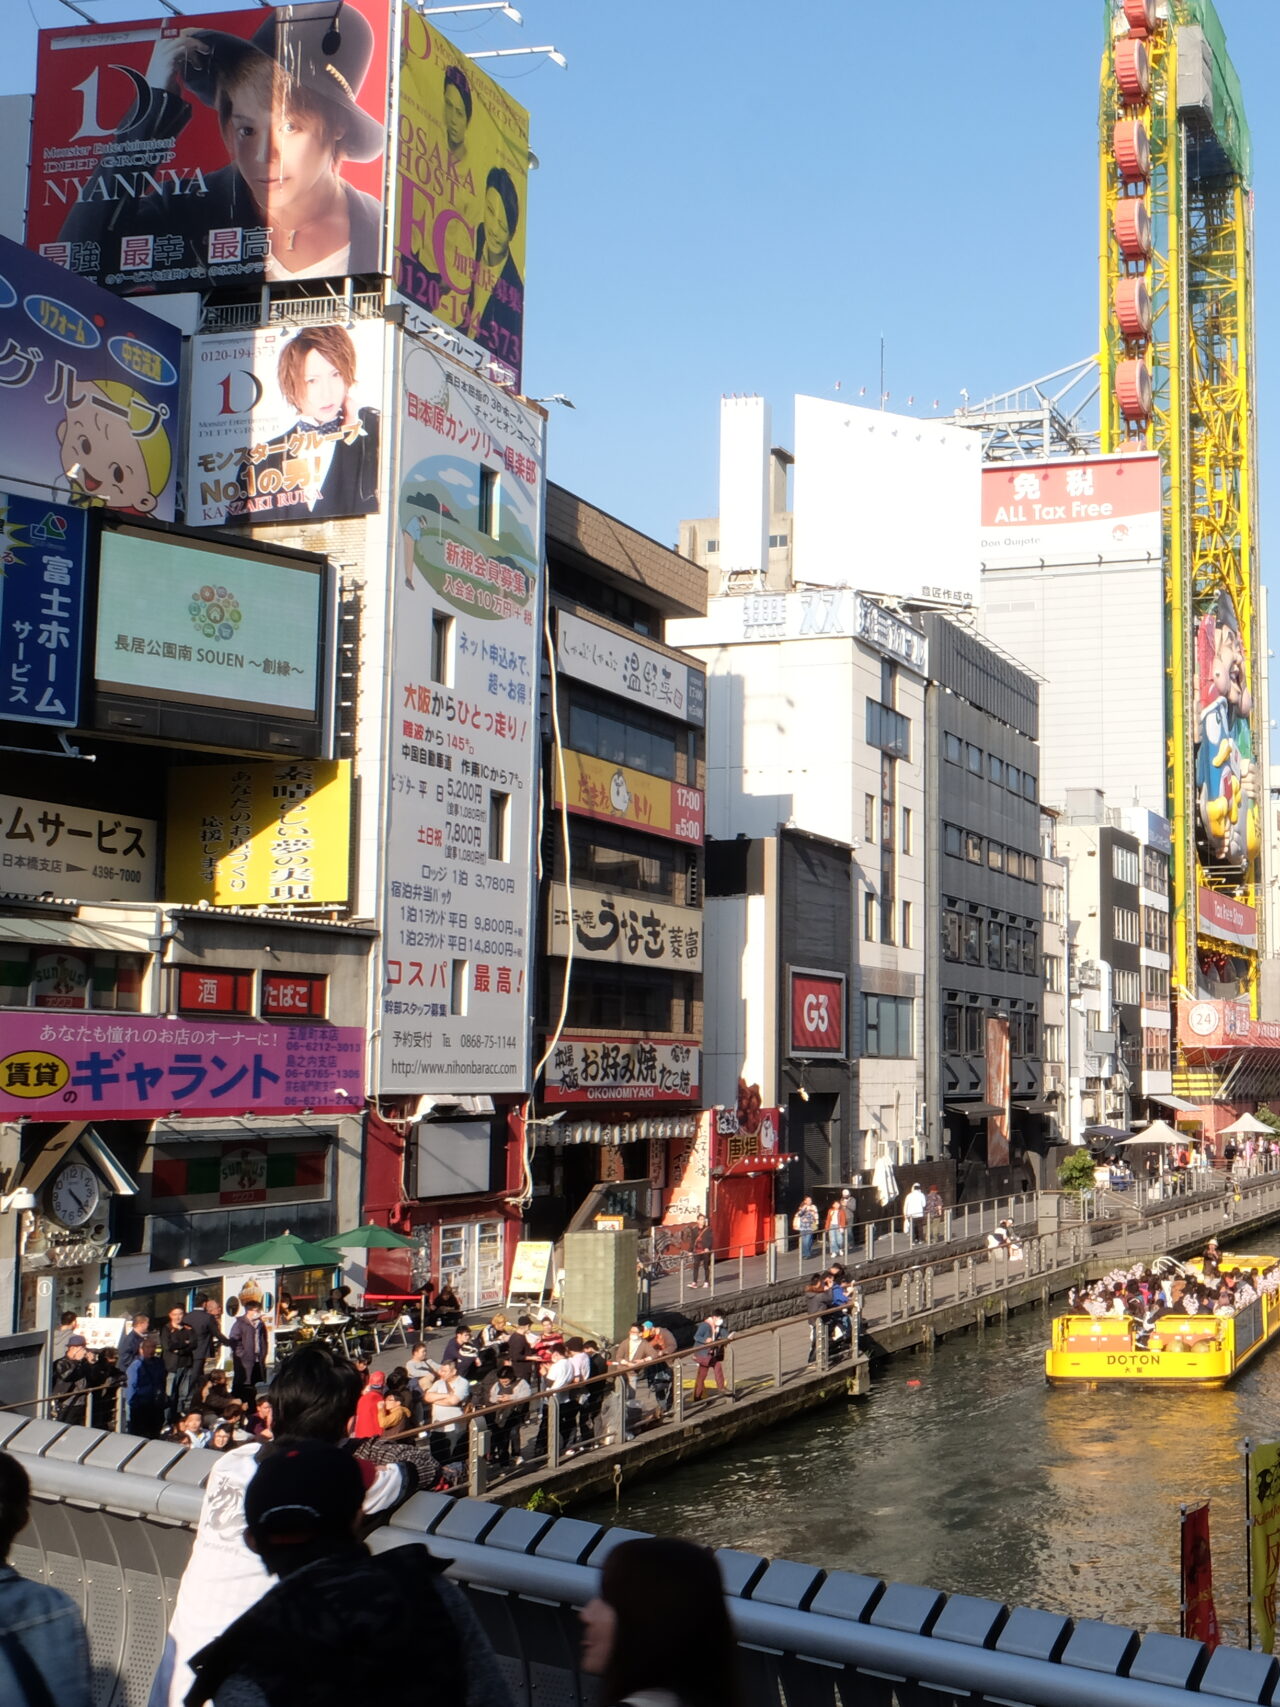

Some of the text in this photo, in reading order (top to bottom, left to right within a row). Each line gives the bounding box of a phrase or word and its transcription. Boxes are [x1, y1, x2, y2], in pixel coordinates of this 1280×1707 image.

[43, 152, 176, 174] DEEP GROUP
[399, 114, 475, 196] OSAKA
[43, 167, 209, 206] NYANNYA
[398, 141, 458, 207] HOST
[208, 226, 273, 264] 最高
[39, 299, 86, 344] リフォーム
[406, 392, 537, 486] 日本原カンツリー倶楽部
[473, 404, 537, 449] チャンピオンコース
[198, 420, 363, 474] モンスターグループ
[202, 494, 273, 520] KANZAKI
[995, 501, 1113, 523] ALL Tax Free
[35, 554, 74, 716] 富士ホーム
[114, 633, 193, 662] 長居公園南
[196, 648, 245, 669] SOUEN
[8, 620, 33, 705] サービス
[623, 651, 673, 705] 温野菜
[677, 788, 700, 811] 17:00
[0, 806, 147, 860] ムサービス
[417, 826, 442, 847] 土日祝
[2, 852, 142, 885] 日本橋支店 4396-7000
[421, 864, 447, 882] ロッジ
[576, 898, 666, 959] うなぎ
[34, 963, 87, 989] sunus
[198, 978, 218, 1004] 酒
[386, 959, 449, 989] コスパ
[263, 983, 309, 1009] たばこ
[804, 994, 828, 1032] G3
[1195, 1012, 1212, 1027] 24
[392, 1030, 433, 1048] 予約受付
[460, 1034, 517, 1049] 0868-75-1144
[4, 1061, 60, 1087] 賃貸
[62, 1049, 281, 1104] の ギャラント
[391, 1058, 518, 1077] http://www.nihonbaracc.com
[580, 1041, 658, 1085] お好み焼
[587, 1086, 654, 1101] OKONOMIYAKI
[1107, 1355, 1160, 1366] DOTON
